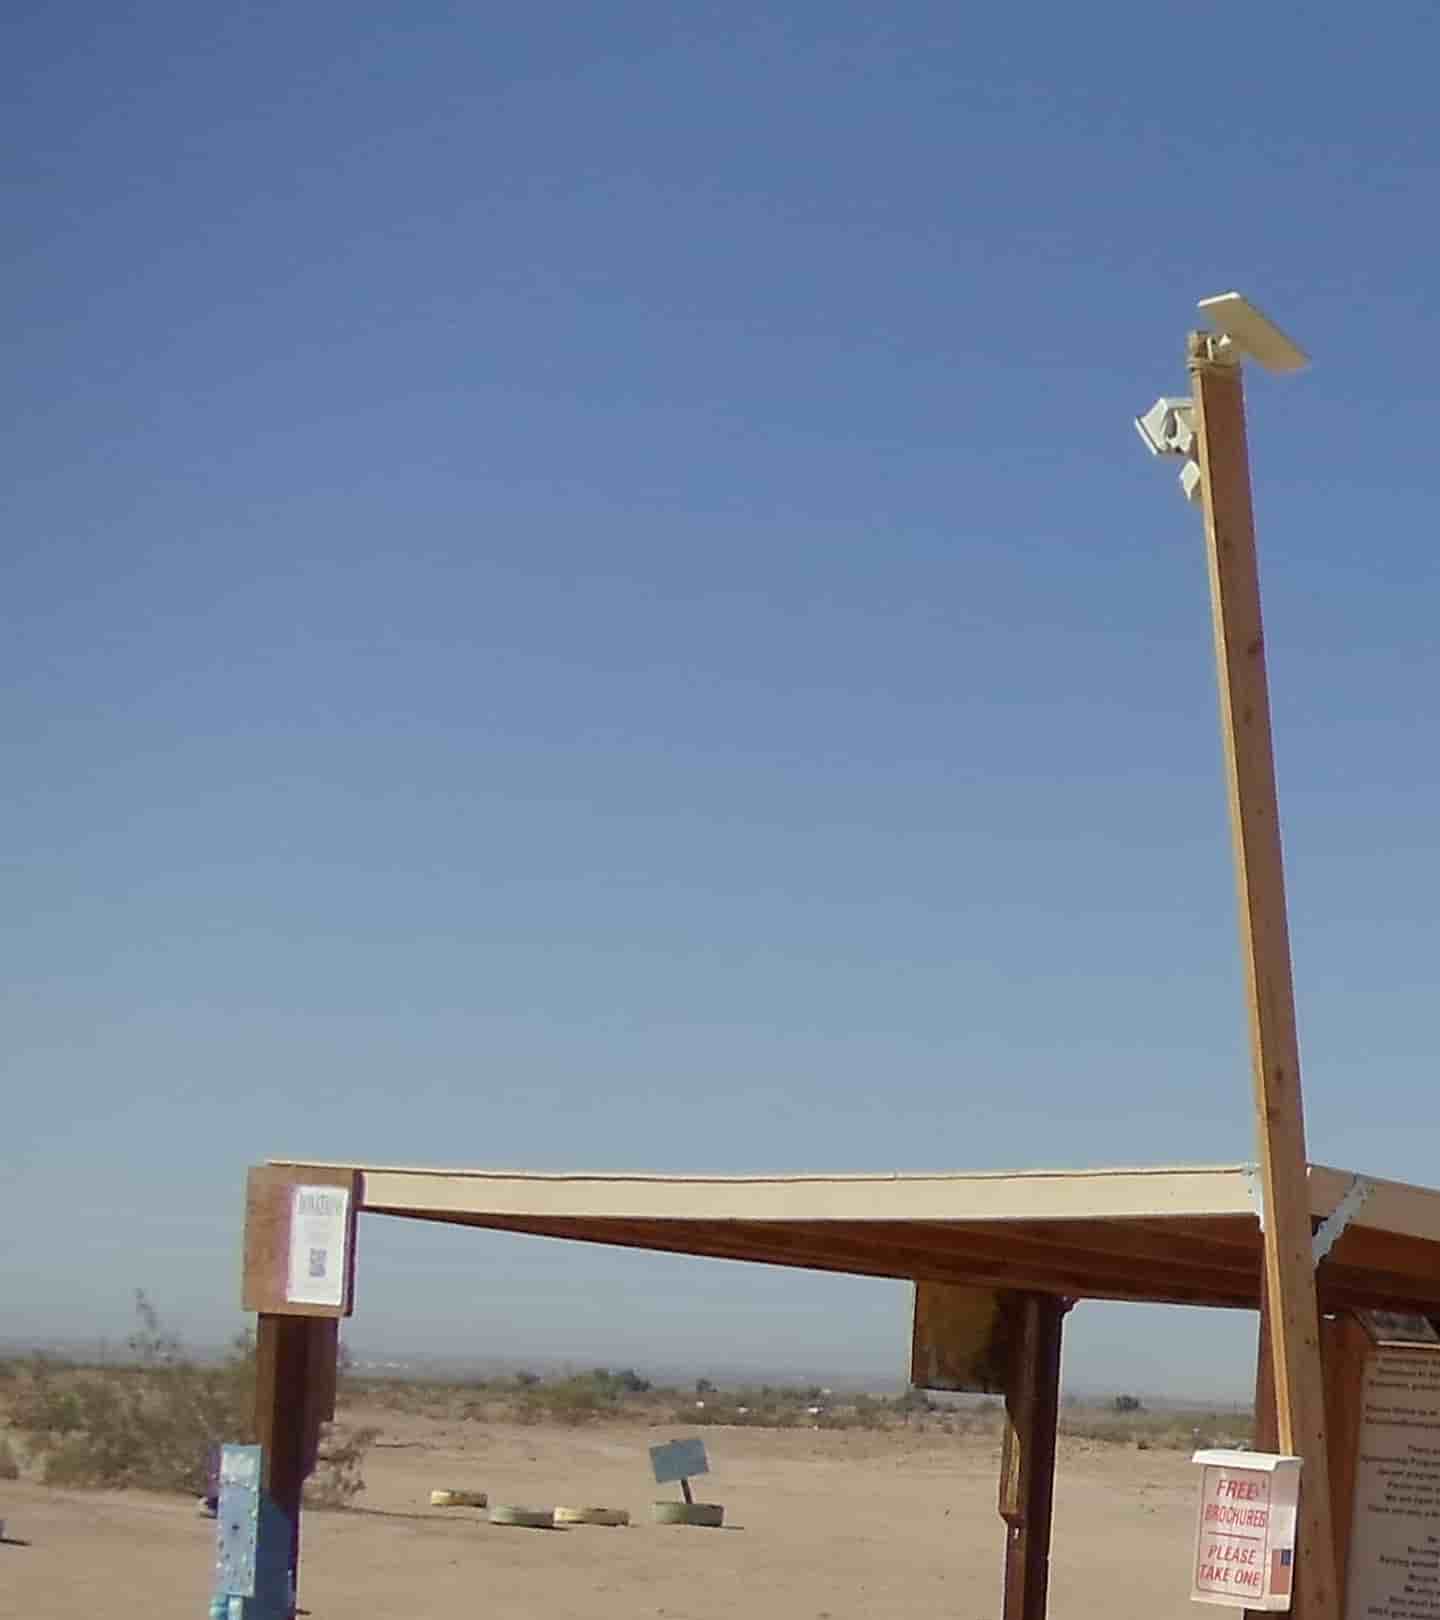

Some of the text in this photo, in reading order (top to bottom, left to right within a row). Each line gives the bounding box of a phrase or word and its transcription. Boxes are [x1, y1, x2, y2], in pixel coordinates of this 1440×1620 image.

[1216, 1478, 1260, 1500] FREE
[1204, 1503, 1266, 1529] BROCHURES
[1207, 1544, 1257, 1565] PLEASE
[1199, 1563, 1262, 1587] TAKE ONE
